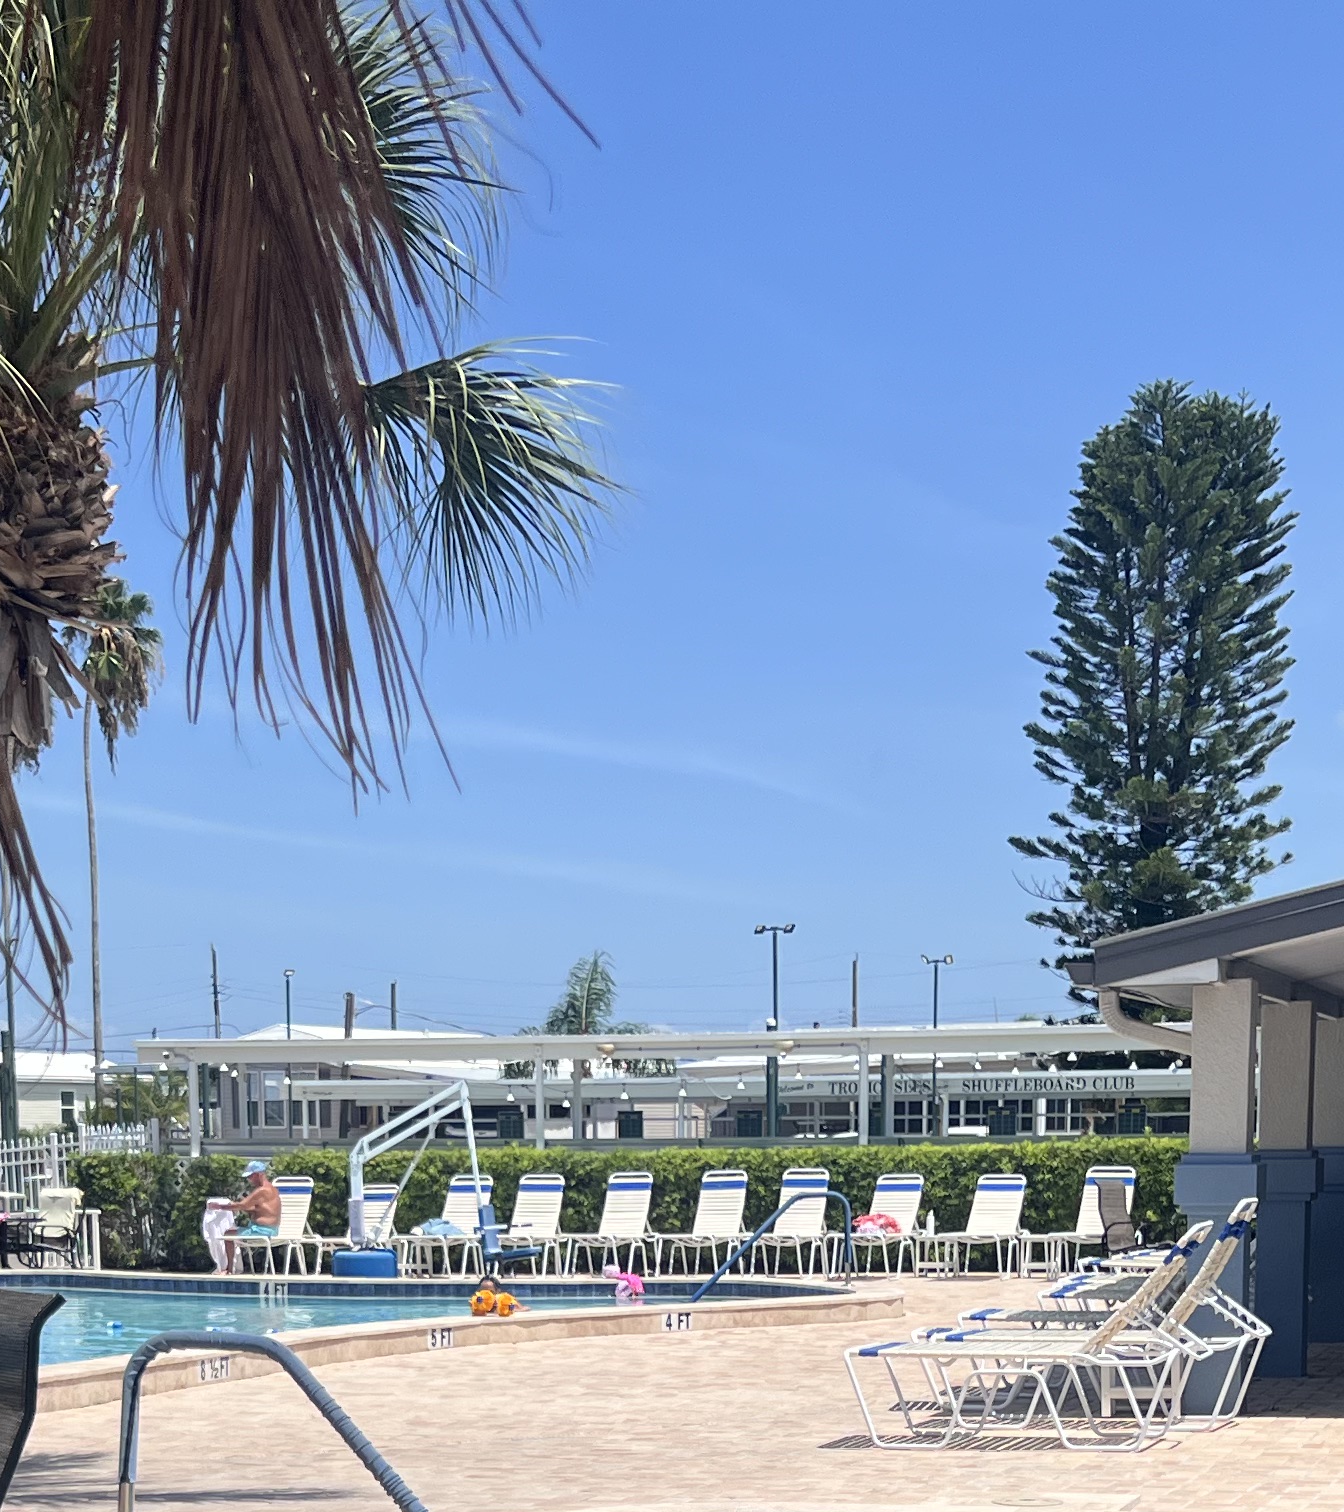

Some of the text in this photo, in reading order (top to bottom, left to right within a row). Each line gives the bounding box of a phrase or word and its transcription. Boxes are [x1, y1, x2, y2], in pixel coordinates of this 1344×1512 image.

[828, 1081, 881, 1095] TROIC
[962, 1077, 1135, 1092] SHUFFLEBOARD CLUB
[274, 1282, 286, 1295] FT
[665, 1312, 691, 1331] 4 FT
[431, 1327, 452, 1347] 5 FT
[200, 1359, 206, 1381] 8
